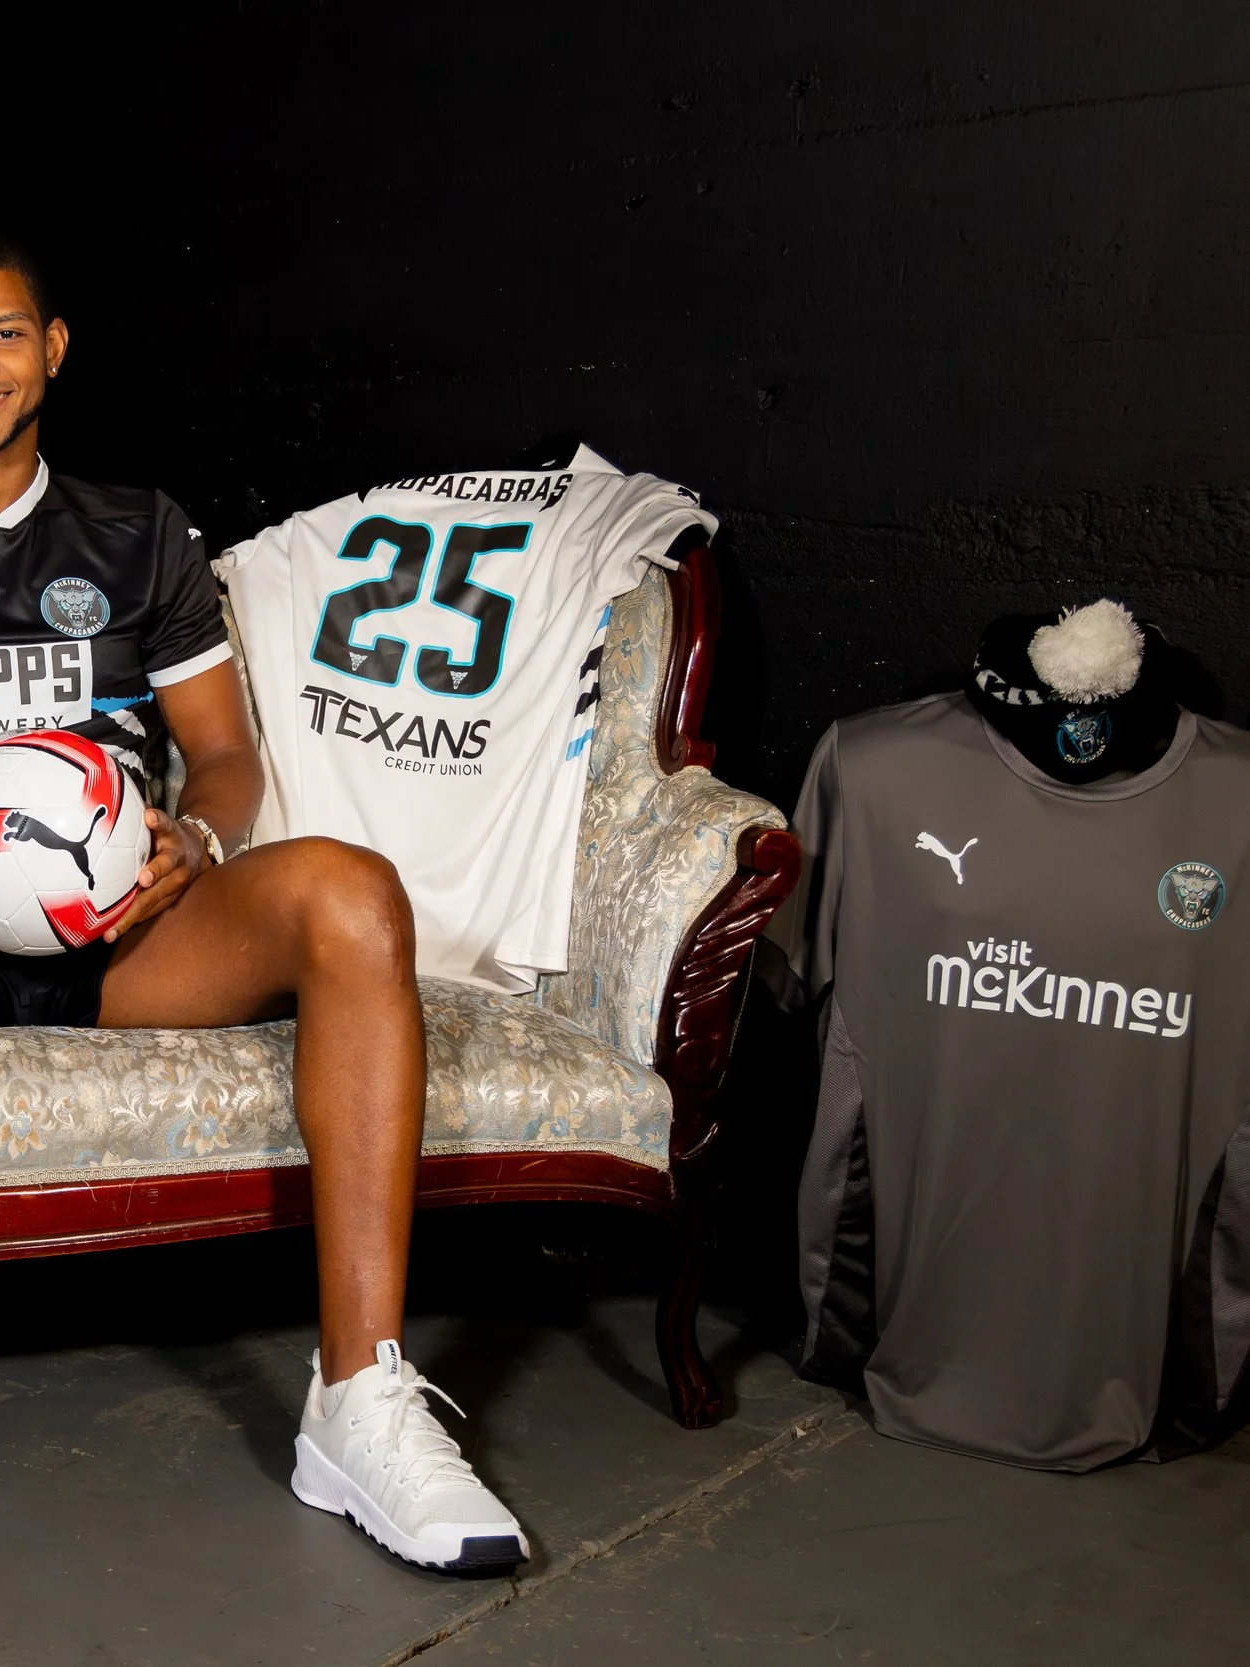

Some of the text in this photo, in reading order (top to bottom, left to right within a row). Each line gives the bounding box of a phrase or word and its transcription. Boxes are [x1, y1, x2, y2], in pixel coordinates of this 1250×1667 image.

[311, 514, 534, 700] 25
[299, 684, 492, 760] TEXANS
[384, 756, 483, 776] CREDIT UNION
[966, 937, 1033, 967] visit
